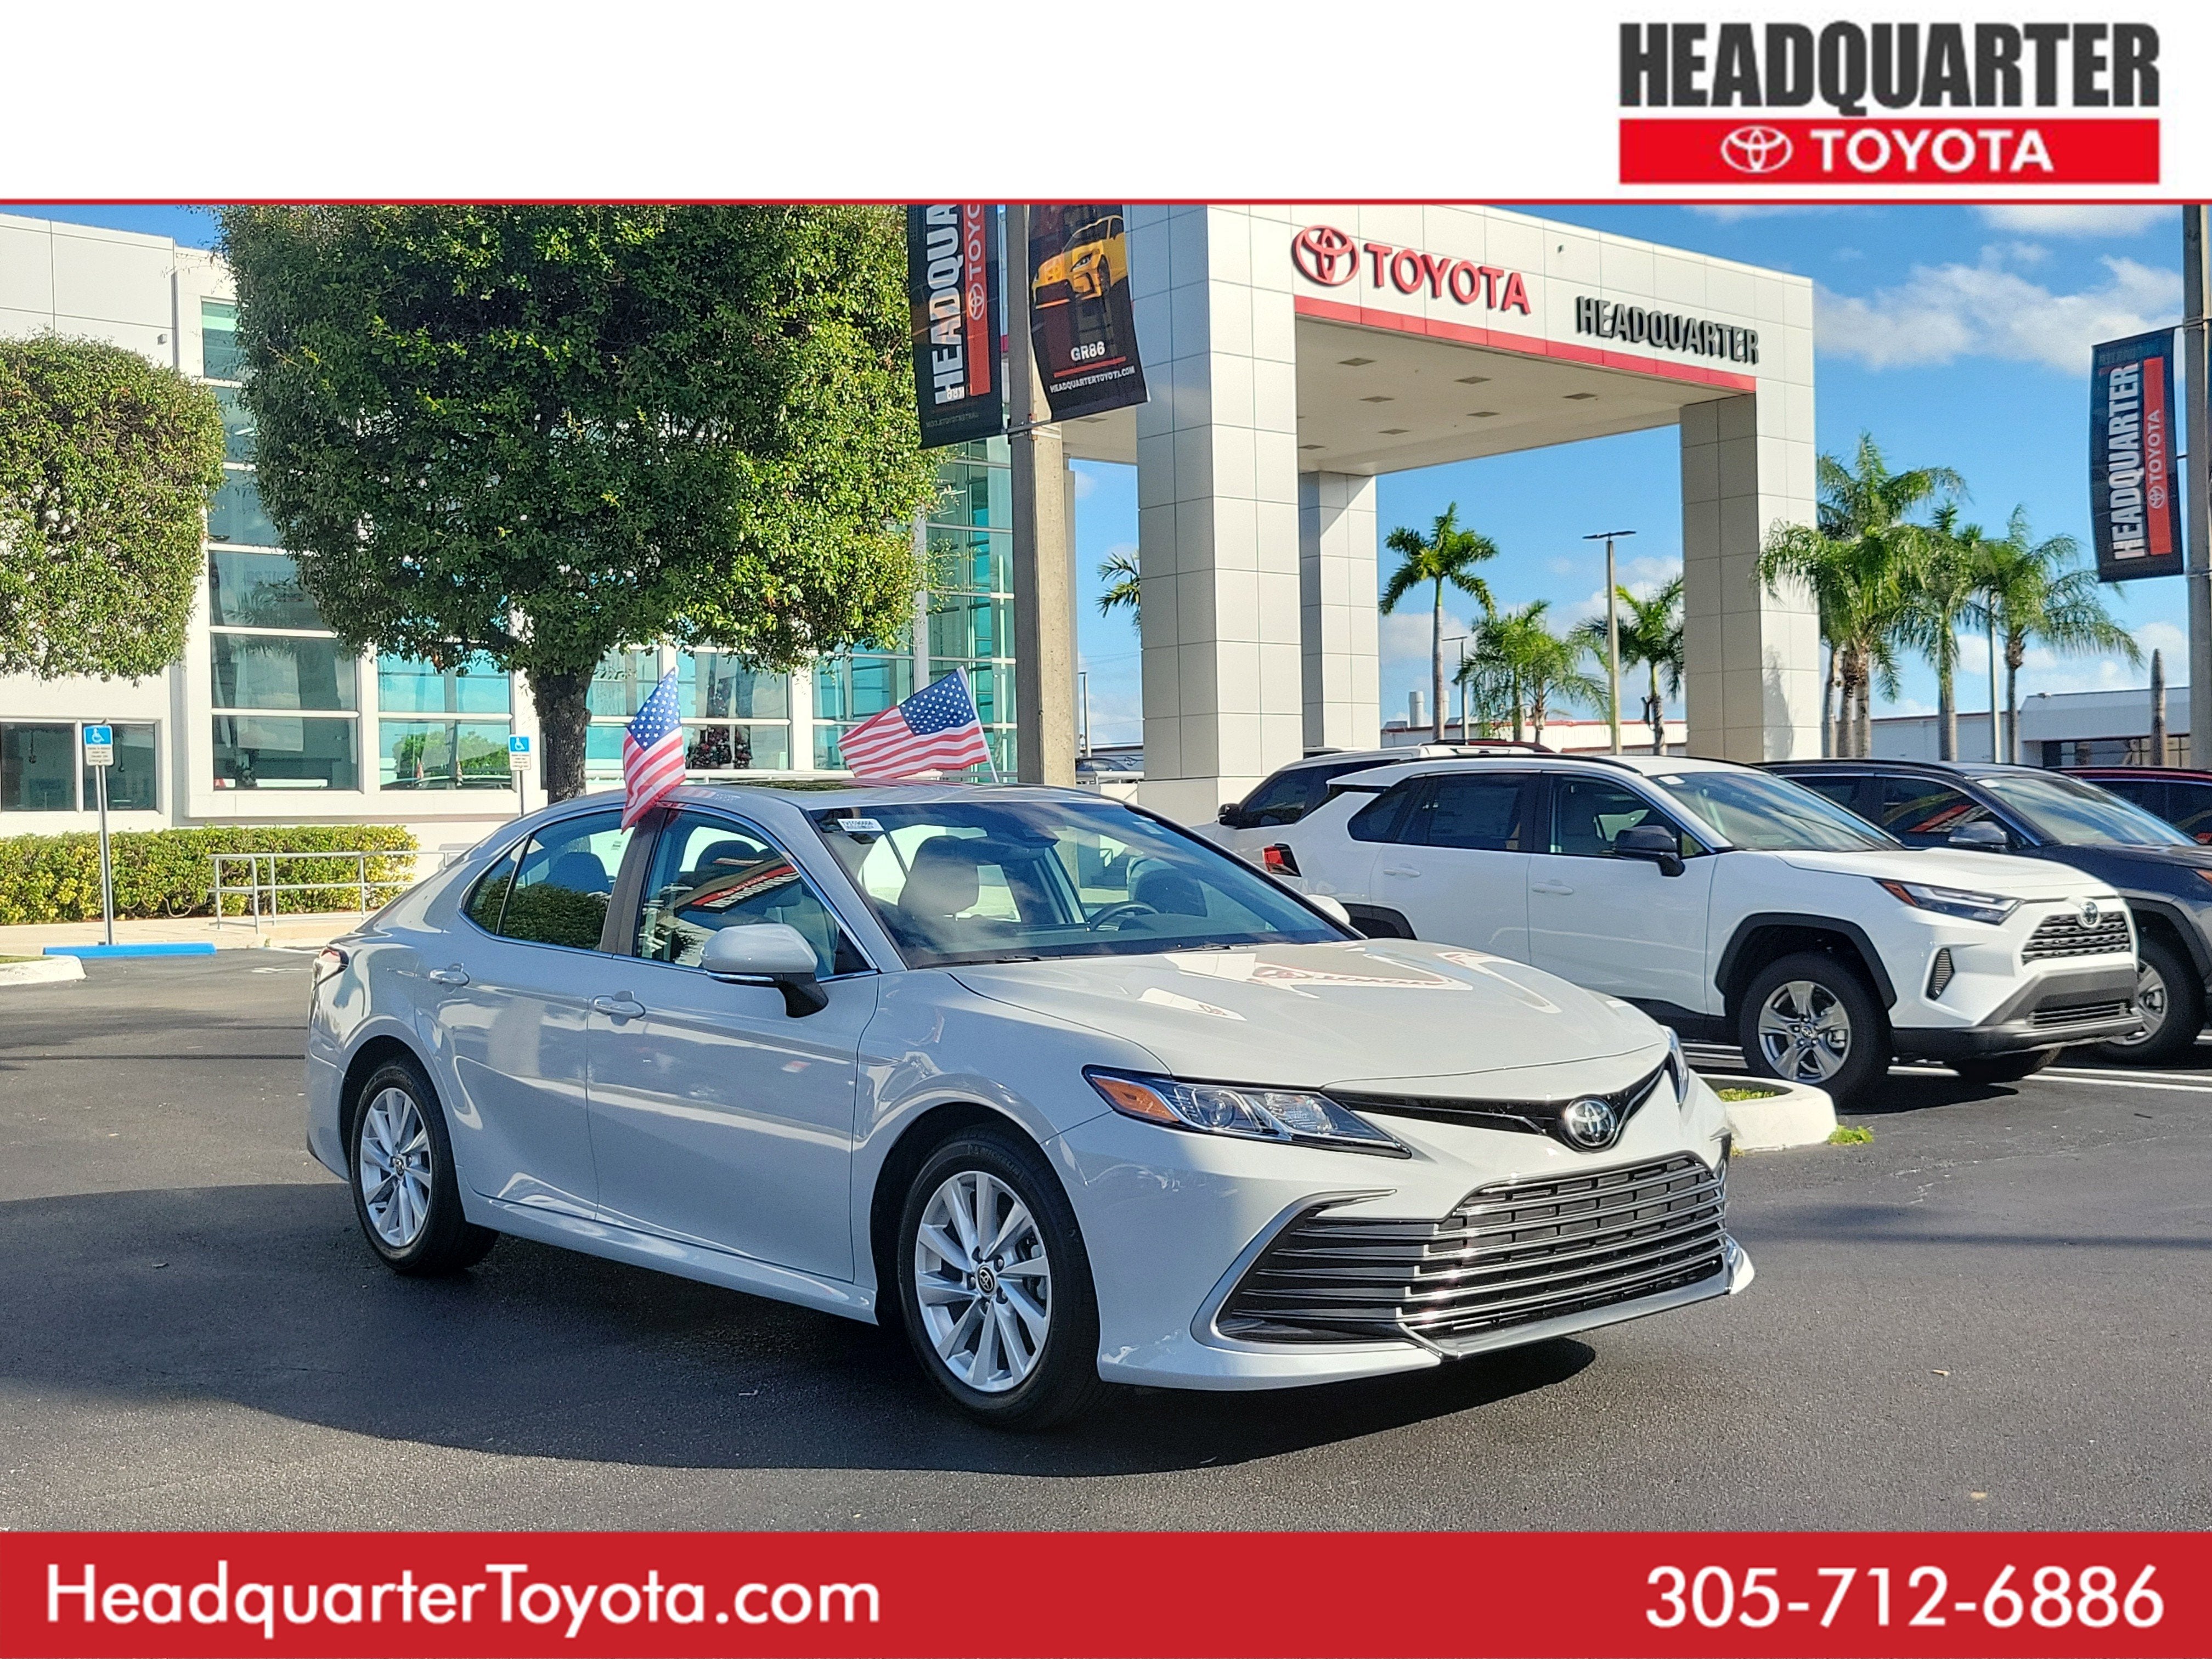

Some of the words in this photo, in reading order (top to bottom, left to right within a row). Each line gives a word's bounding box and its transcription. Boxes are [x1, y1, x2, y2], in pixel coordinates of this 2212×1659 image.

[1363, 242, 1531, 315] TOYOTA
[1070, 341, 1105, 362] GR86
[1575, 296, 1759, 364] HEADQUARTER
[2108, 362, 2146, 560] HEADQUARTER
[2147, 409, 2163, 484] TOYOTA
